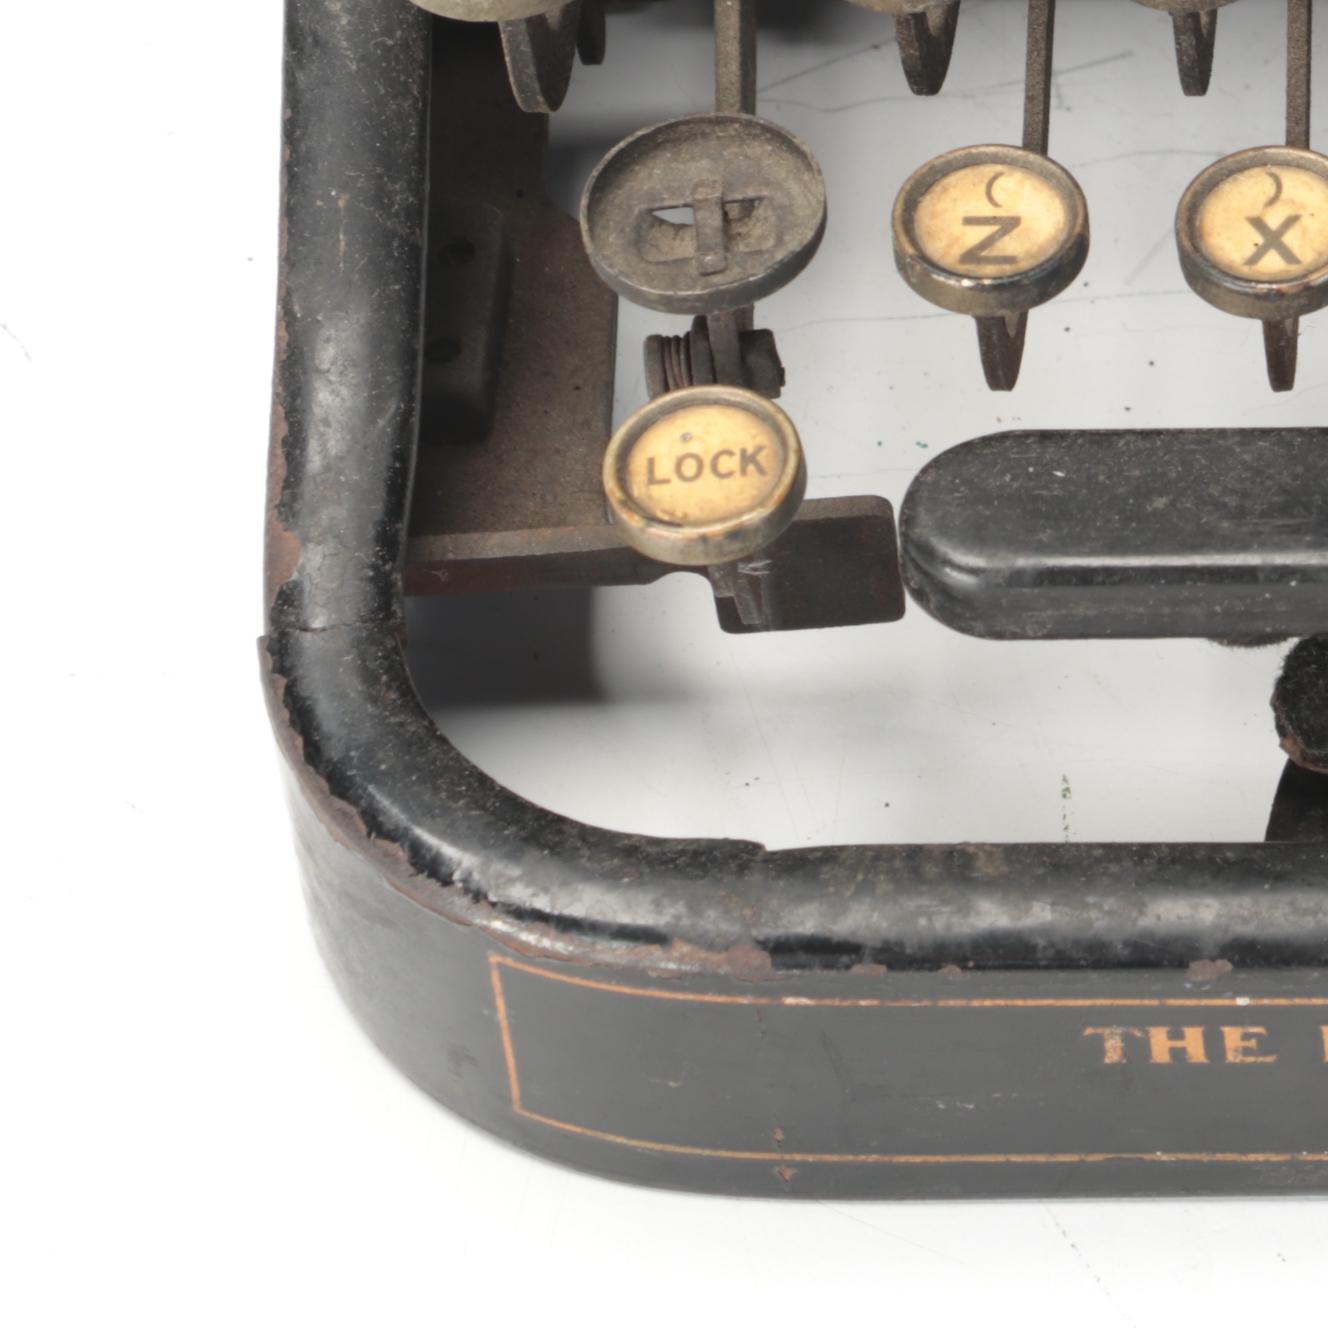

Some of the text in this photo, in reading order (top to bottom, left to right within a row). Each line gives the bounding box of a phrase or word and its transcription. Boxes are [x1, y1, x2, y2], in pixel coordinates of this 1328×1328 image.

[958, 215, 1022, 266] Z
[1242, 214, 1303, 266] X
[645, 445, 768, 486] LOCK
[1083, 1026, 1279, 1064] THE
